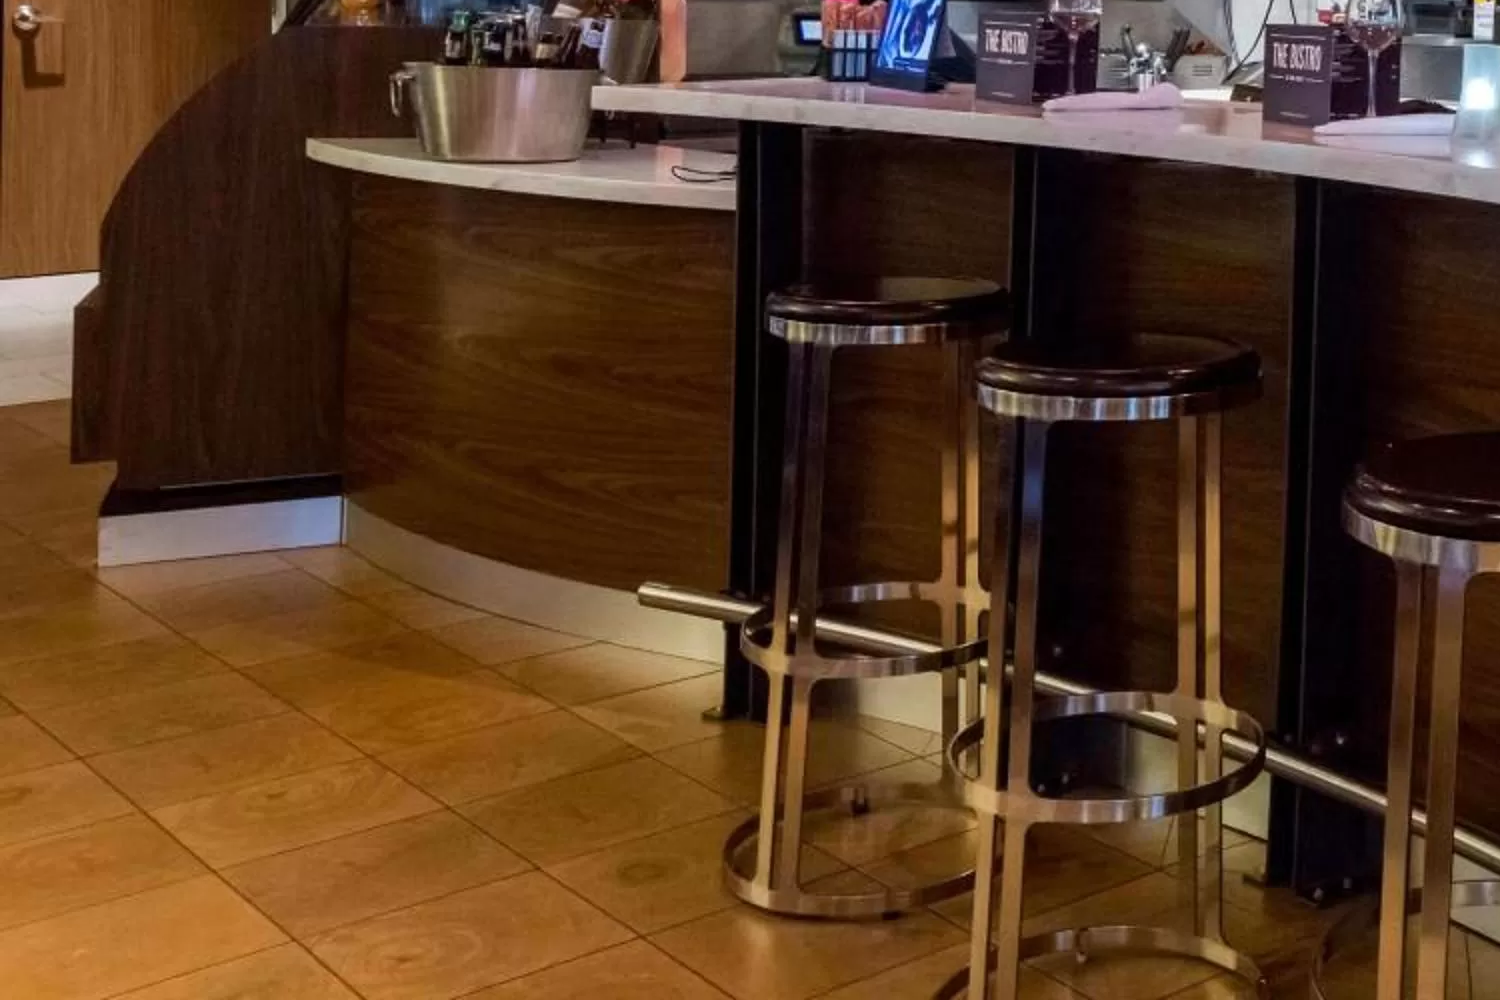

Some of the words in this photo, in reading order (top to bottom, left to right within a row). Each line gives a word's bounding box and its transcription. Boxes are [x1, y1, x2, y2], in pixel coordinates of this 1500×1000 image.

[984, 28, 1000, 53] THE
[1001, 30, 1029, 55] BISTRO
[1273, 41, 1288, 68] THE
[1290, 43, 1322, 72] BISTRO
